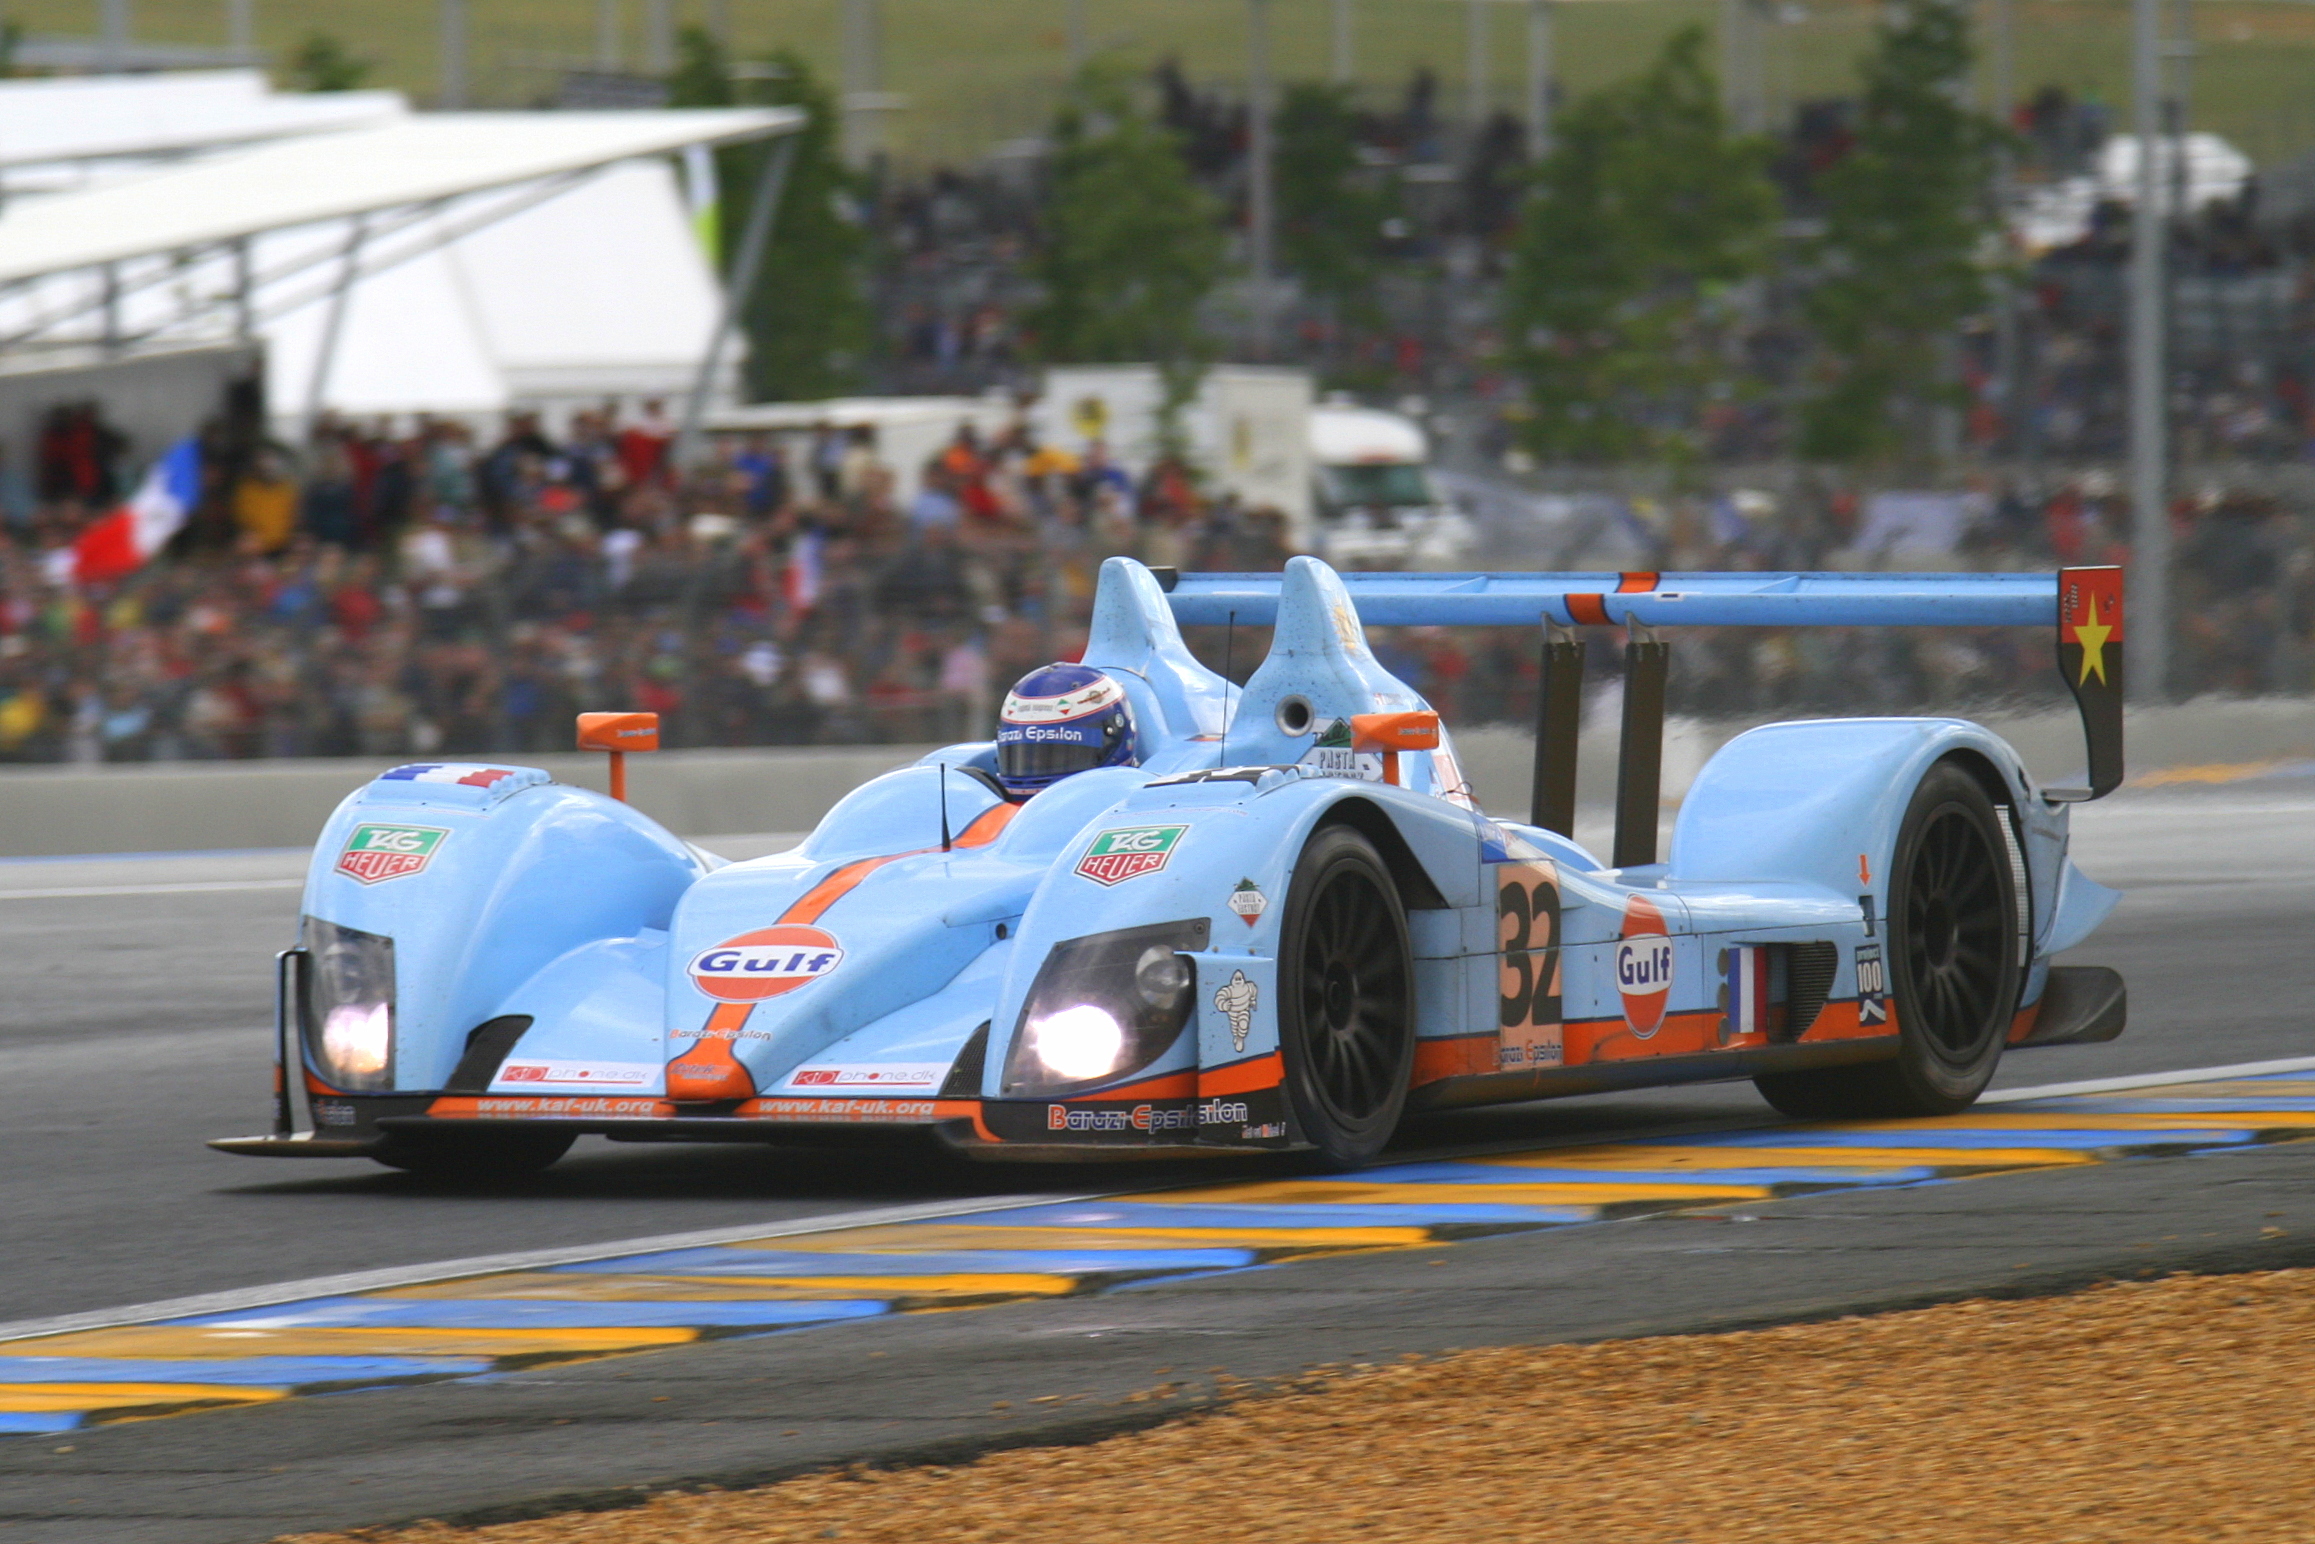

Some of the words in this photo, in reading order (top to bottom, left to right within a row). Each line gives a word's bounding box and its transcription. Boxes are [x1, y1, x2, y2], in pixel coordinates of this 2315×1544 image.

[1025, 726, 1082, 742] Epsilon
[1319, 751, 1356, 770] PASTA
[365, 829, 424, 851] TAG
[1106, 830, 1164, 852] TAG
[341, 852, 420, 878] HEUER
[1084, 854, 1160, 879] HEUER
[698, 951, 836, 972] Gulf
[1501, 881, 1562, 1027] 32
[1619, 946, 1670, 985] Gulf
[1858, 961, 1883, 993] 100
[477, 1098, 655, 1113] www.kaf-uk.org
[759, 1100, 935, 1115] www.kaf-uk.org
